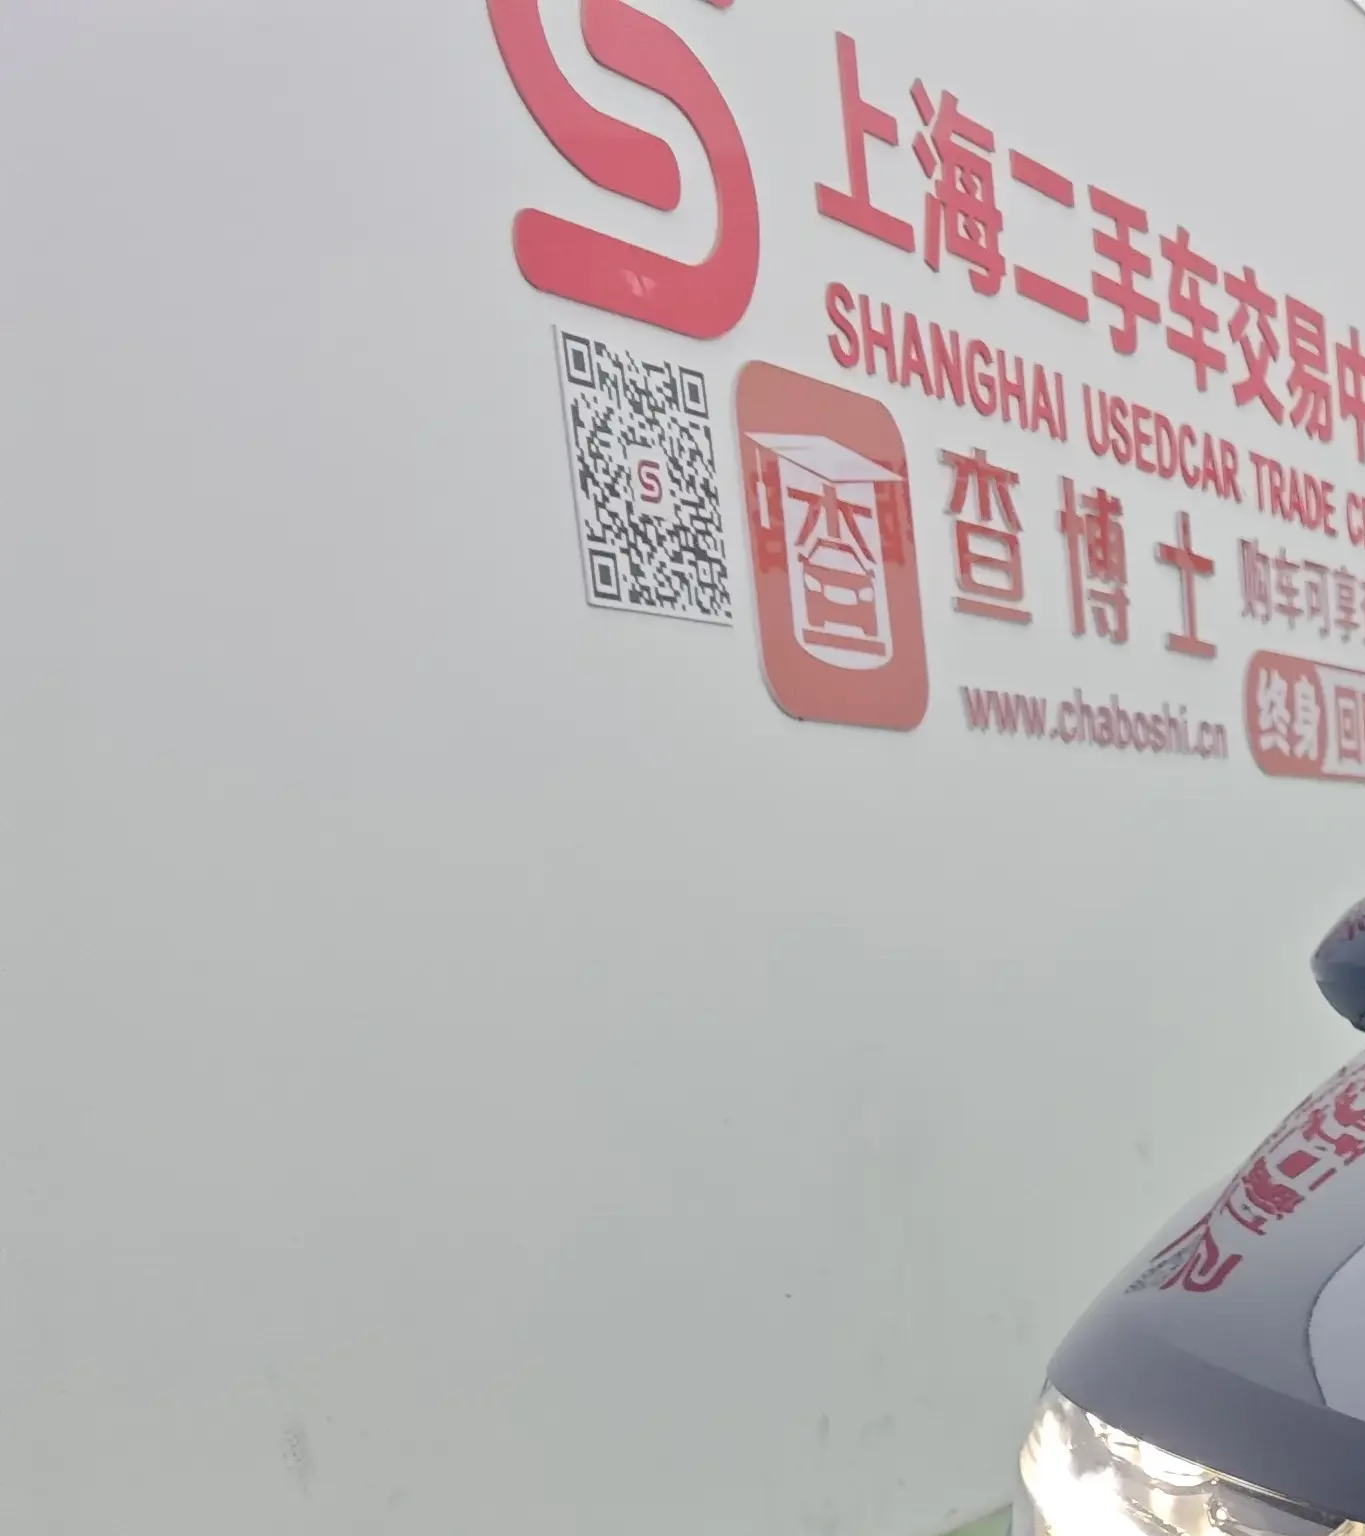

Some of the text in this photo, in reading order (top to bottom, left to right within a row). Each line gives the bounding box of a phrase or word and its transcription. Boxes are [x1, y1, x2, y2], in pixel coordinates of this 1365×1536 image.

[825, 281, 1067, 443] SHANGHAI
[1084, 388, 1242, 505] USEDCAR
[1249, 450, 1337, 539] TRADE
[938, 447, 1218, 660] 查博士
[960, 684, 1228, 759] www.chaboshi.cn
[1257, 666, 1321, 761] 终身
